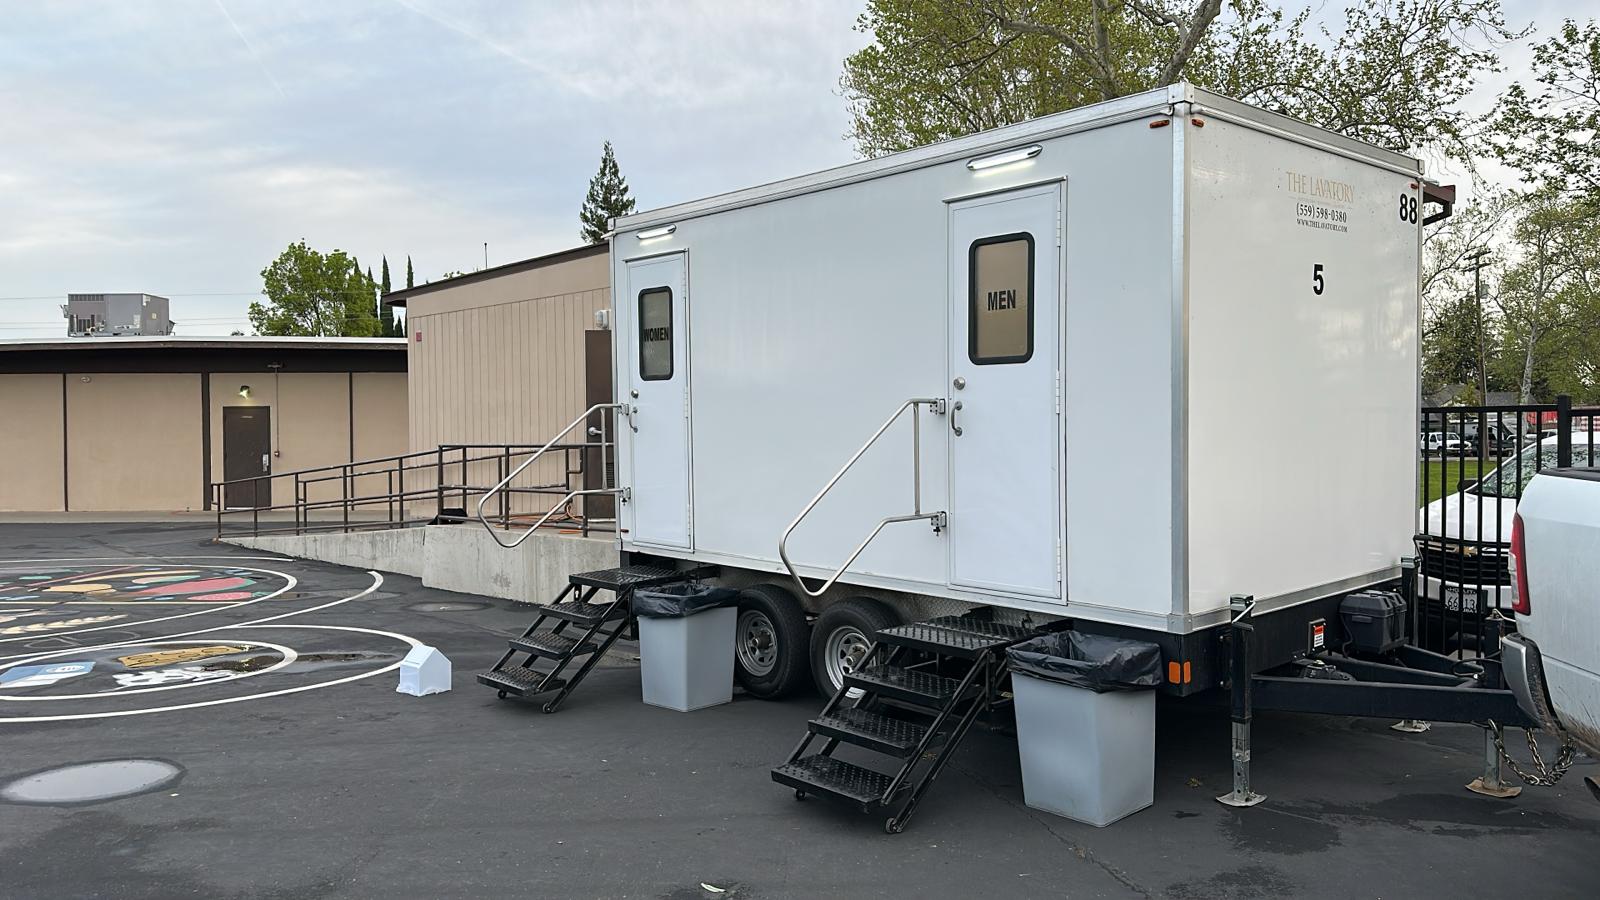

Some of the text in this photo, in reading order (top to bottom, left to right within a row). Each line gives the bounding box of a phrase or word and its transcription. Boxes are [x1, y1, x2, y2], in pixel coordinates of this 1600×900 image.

[1286, 171, 1354, 203] THE LAVATORY
[1400, 193, 1418, 224] 88
[1313, 264, 1324, 295] 5
[987, 289, 1016, 311] MEN
[643, 327, 669, 342] WOMEN
